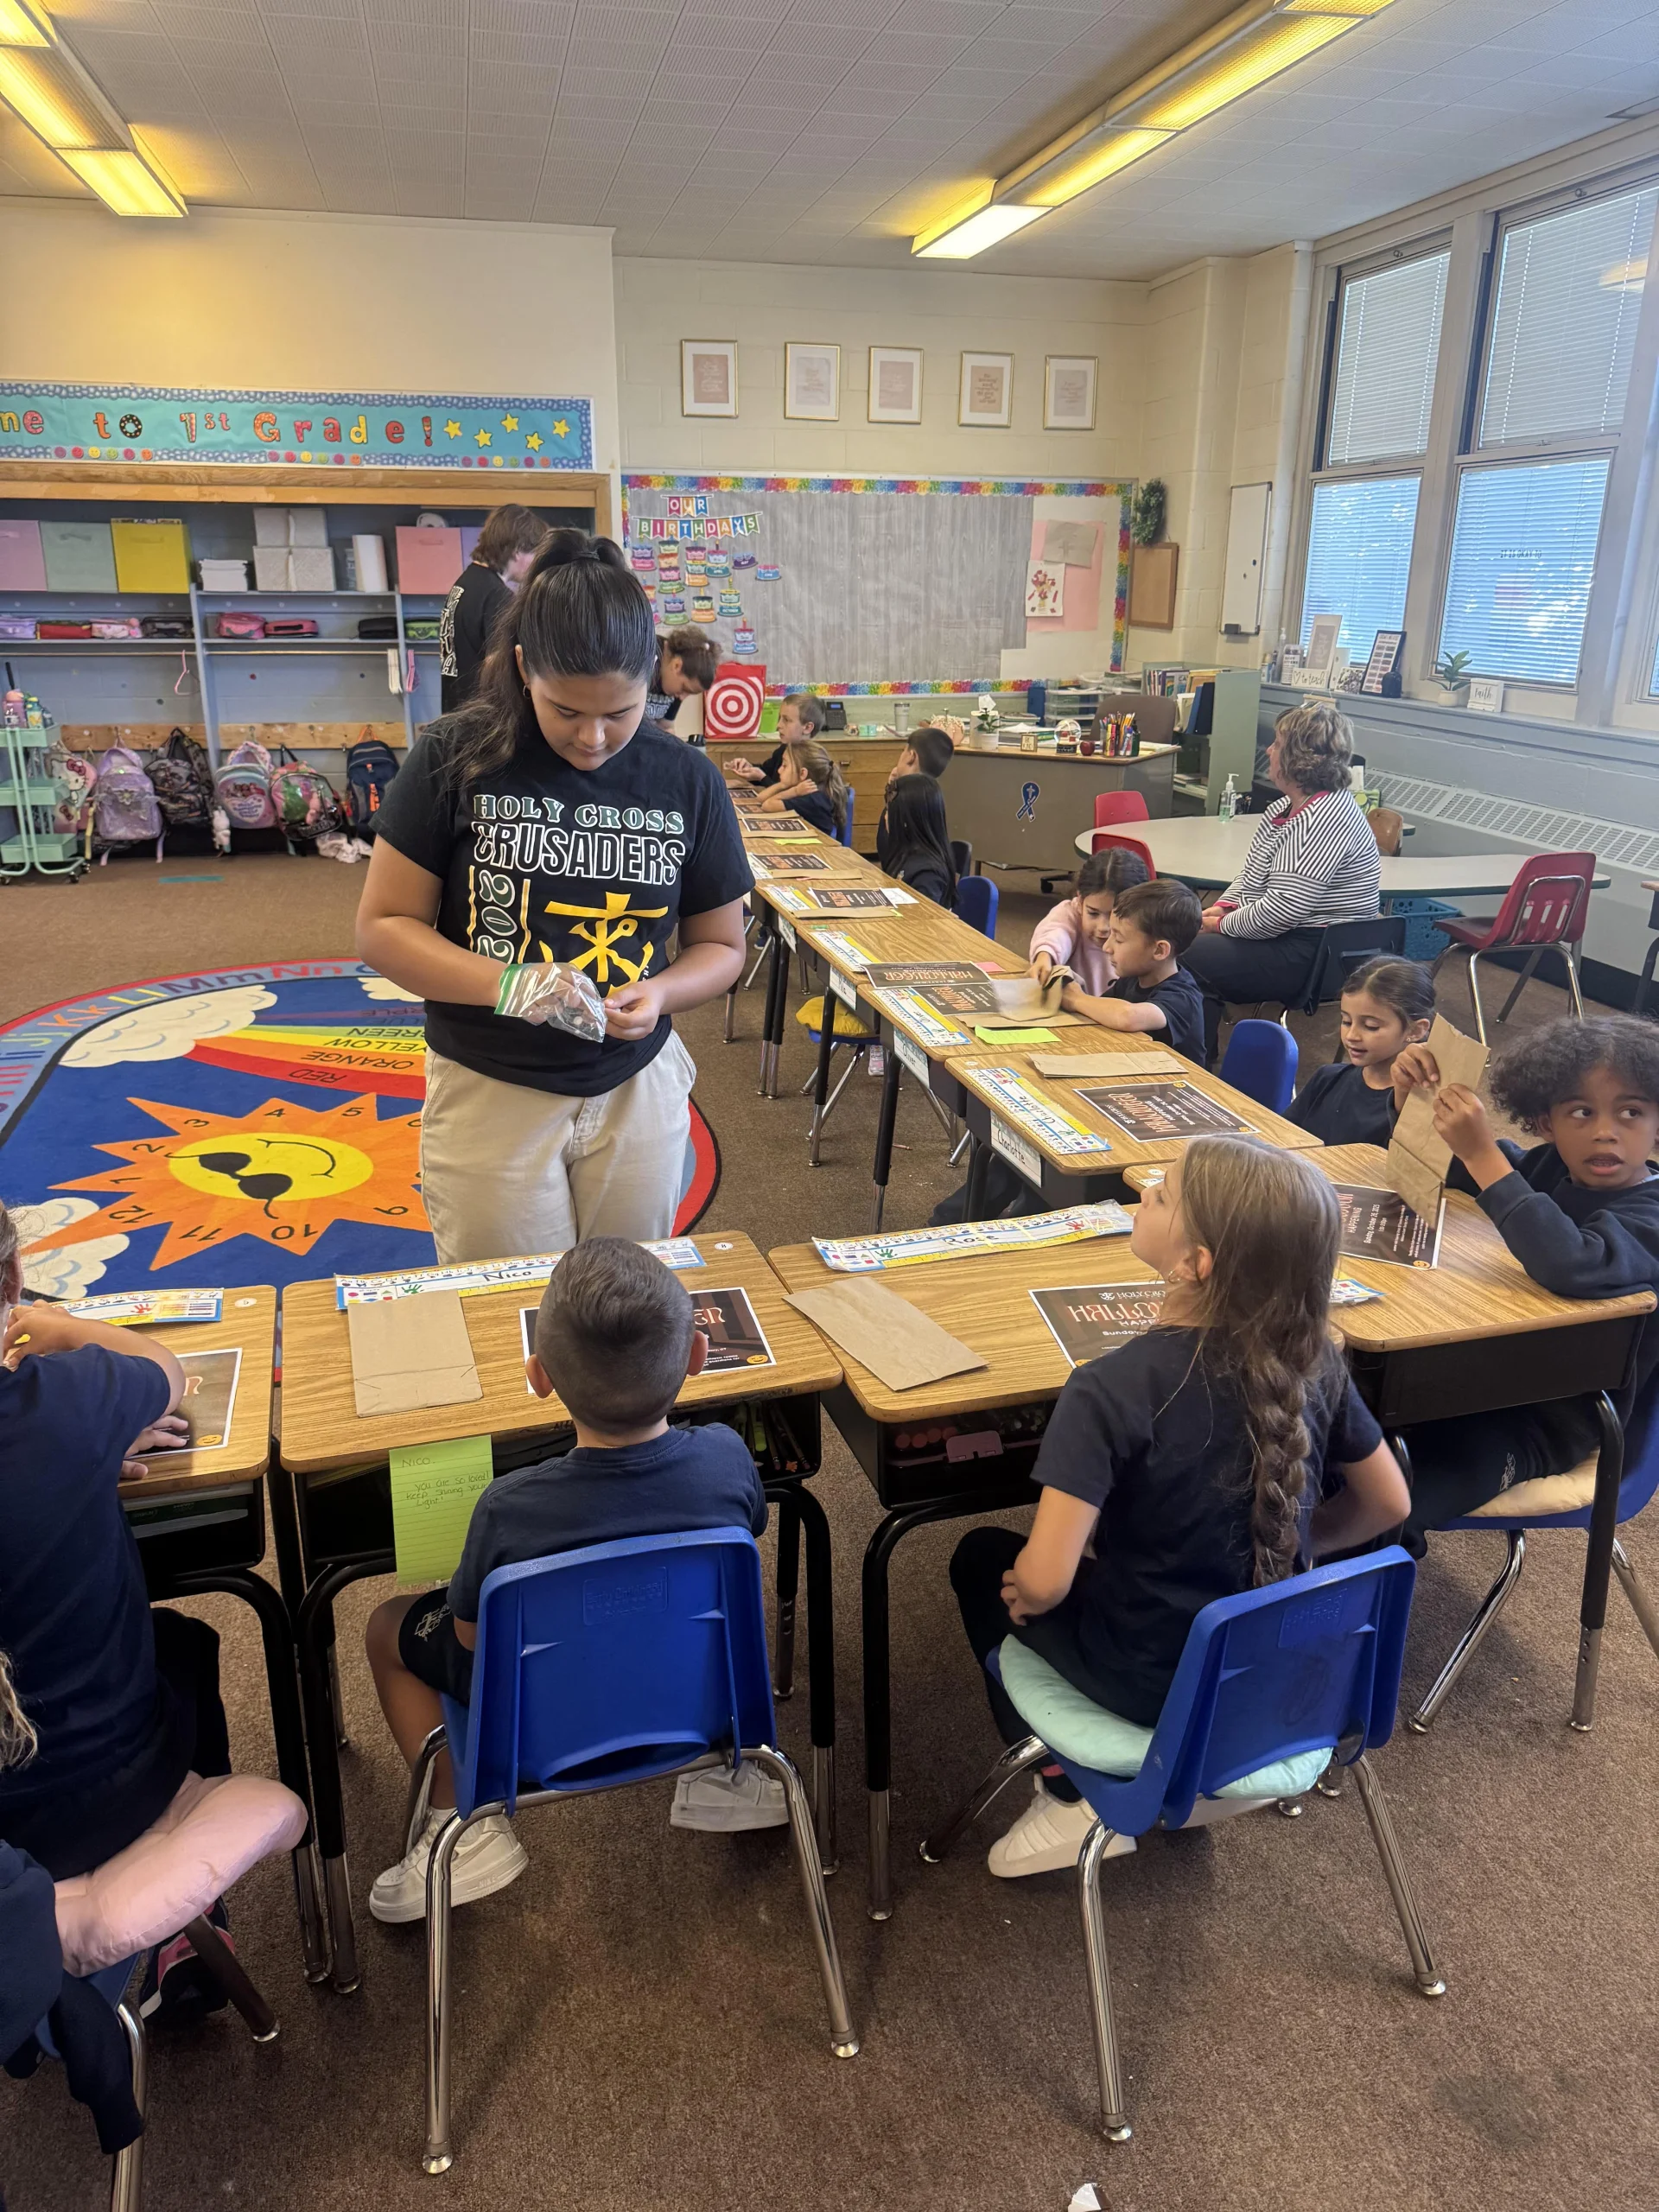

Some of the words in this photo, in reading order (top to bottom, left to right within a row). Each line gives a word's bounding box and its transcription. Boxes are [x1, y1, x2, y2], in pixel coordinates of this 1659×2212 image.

[92, 412, 143, 439] to
[180, 412, 231, 442] 1st
[253, 411, 433, 447] Grade!
[670, 499, 704, 511] OUR
[642, 517, 755, 534] BIRTHDAYS
[1474, 685, 1493, 700] Faith
[473, 794, 565, 823] HOLY
[574, 804, 685, 835] CROSS
[471, 822, 686, 886] CRUSADERS
[301, 1051, 415, 1070] ORANGE
[289, 1068, 347, 1084] RED
[264, 1107, 288, 1119] 4
[341, 1107, 365, 1118] 5
[1019, 1096, 1056, 1125] Charlotte
[184, 1118, 210, 1128] 3
[131, 1142, 166, 1154] 2
[996, 1128, 1026, 1165] Charlotte
[109, 1176, 143, 1185] 1
[108, 1205, 156, 1224] 12
[372, 1205, 410, 1216] 9
[177, 1224, 225, 1241] 11
[270, 1224, 319, 1241] 10
[944, 1235, 1000, 1246] Rose
[482, 1270, 532, 1282] Nico
[1066, 1301, 1160, 1322] HALLO
[468, 1470, 491, 1483] loved!
